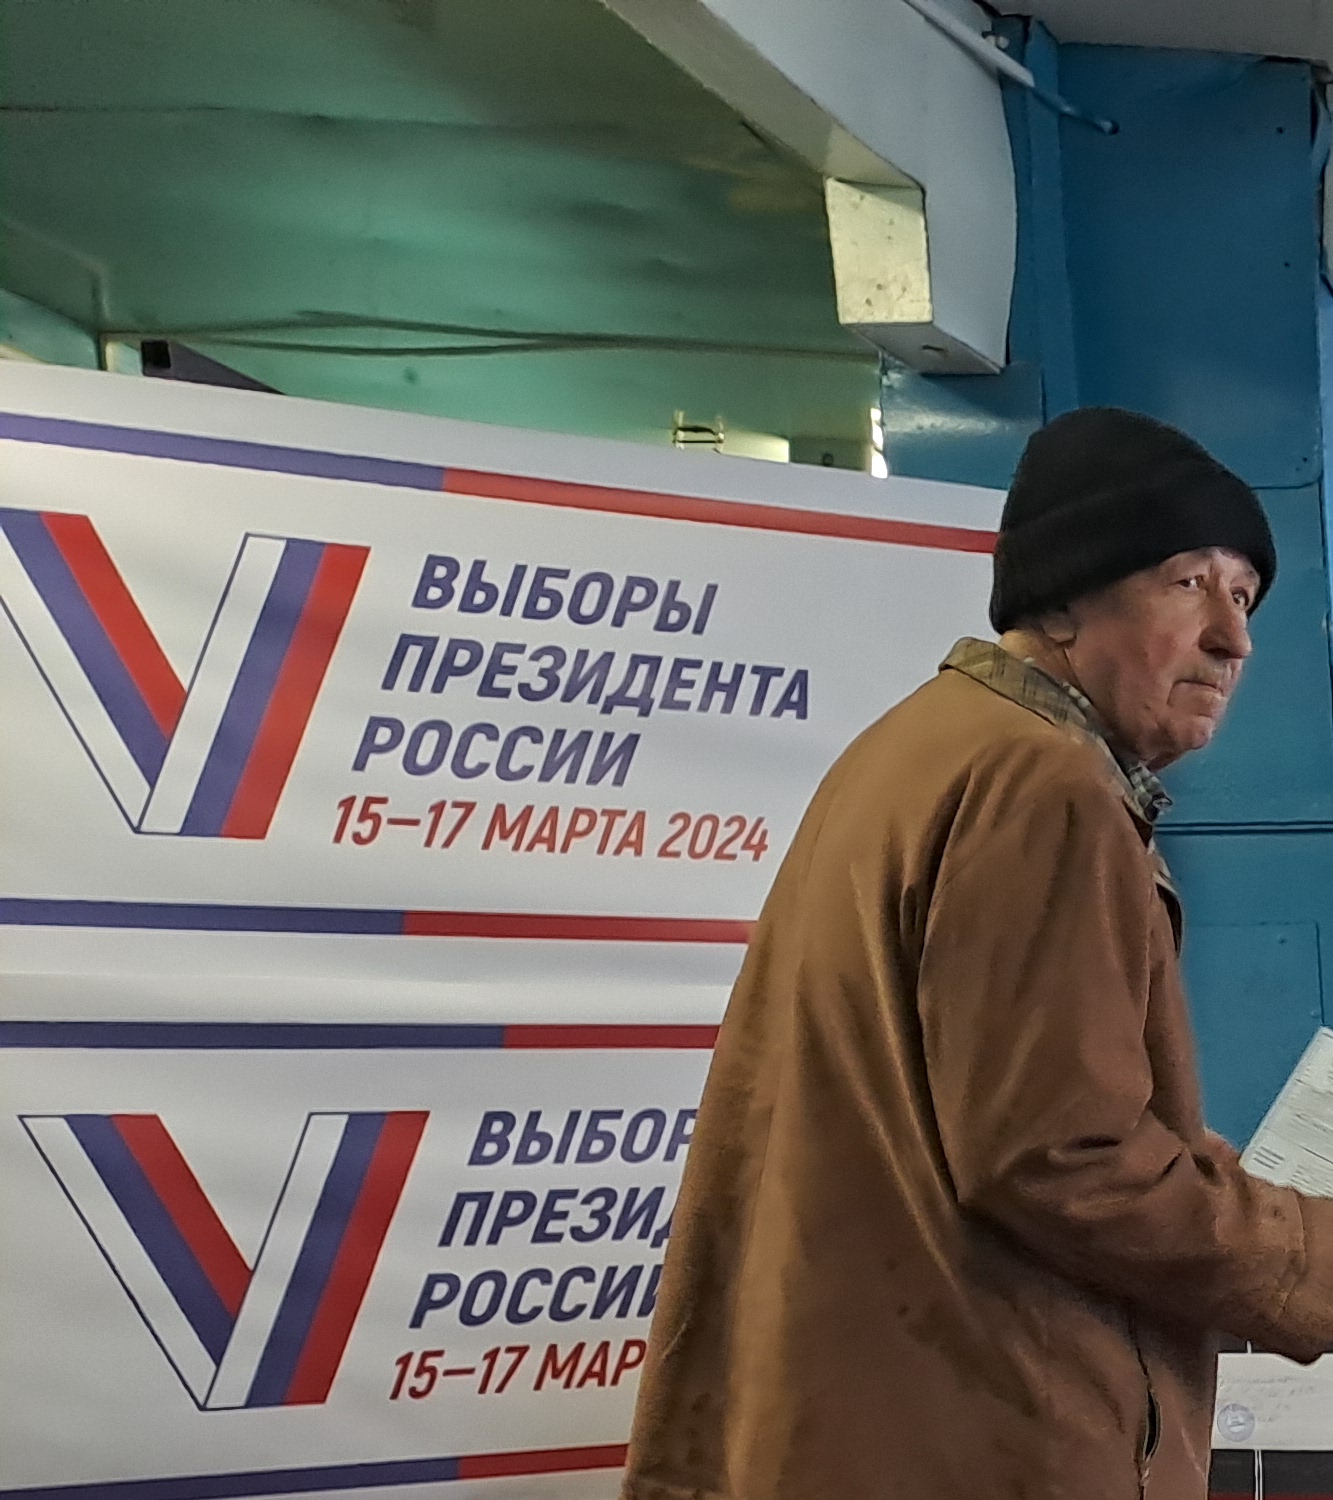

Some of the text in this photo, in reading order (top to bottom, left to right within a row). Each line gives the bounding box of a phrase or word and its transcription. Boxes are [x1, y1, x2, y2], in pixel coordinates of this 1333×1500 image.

[411, 553, 719, 636] ВЫБОРЫ
[380, 632, 809, 721] ПРЕЗИДЕНТА
[351, 716, 642, 788] РОССИИ
[332, 794, 769, 862] 15–17 МАРТА 2024
[468, 1107, 700, 1168] ВЫБОР
[437, 1185, 674, 1249] ПРЕЗИ
[388, 1338, 647, 1401] 15–17 МАР
